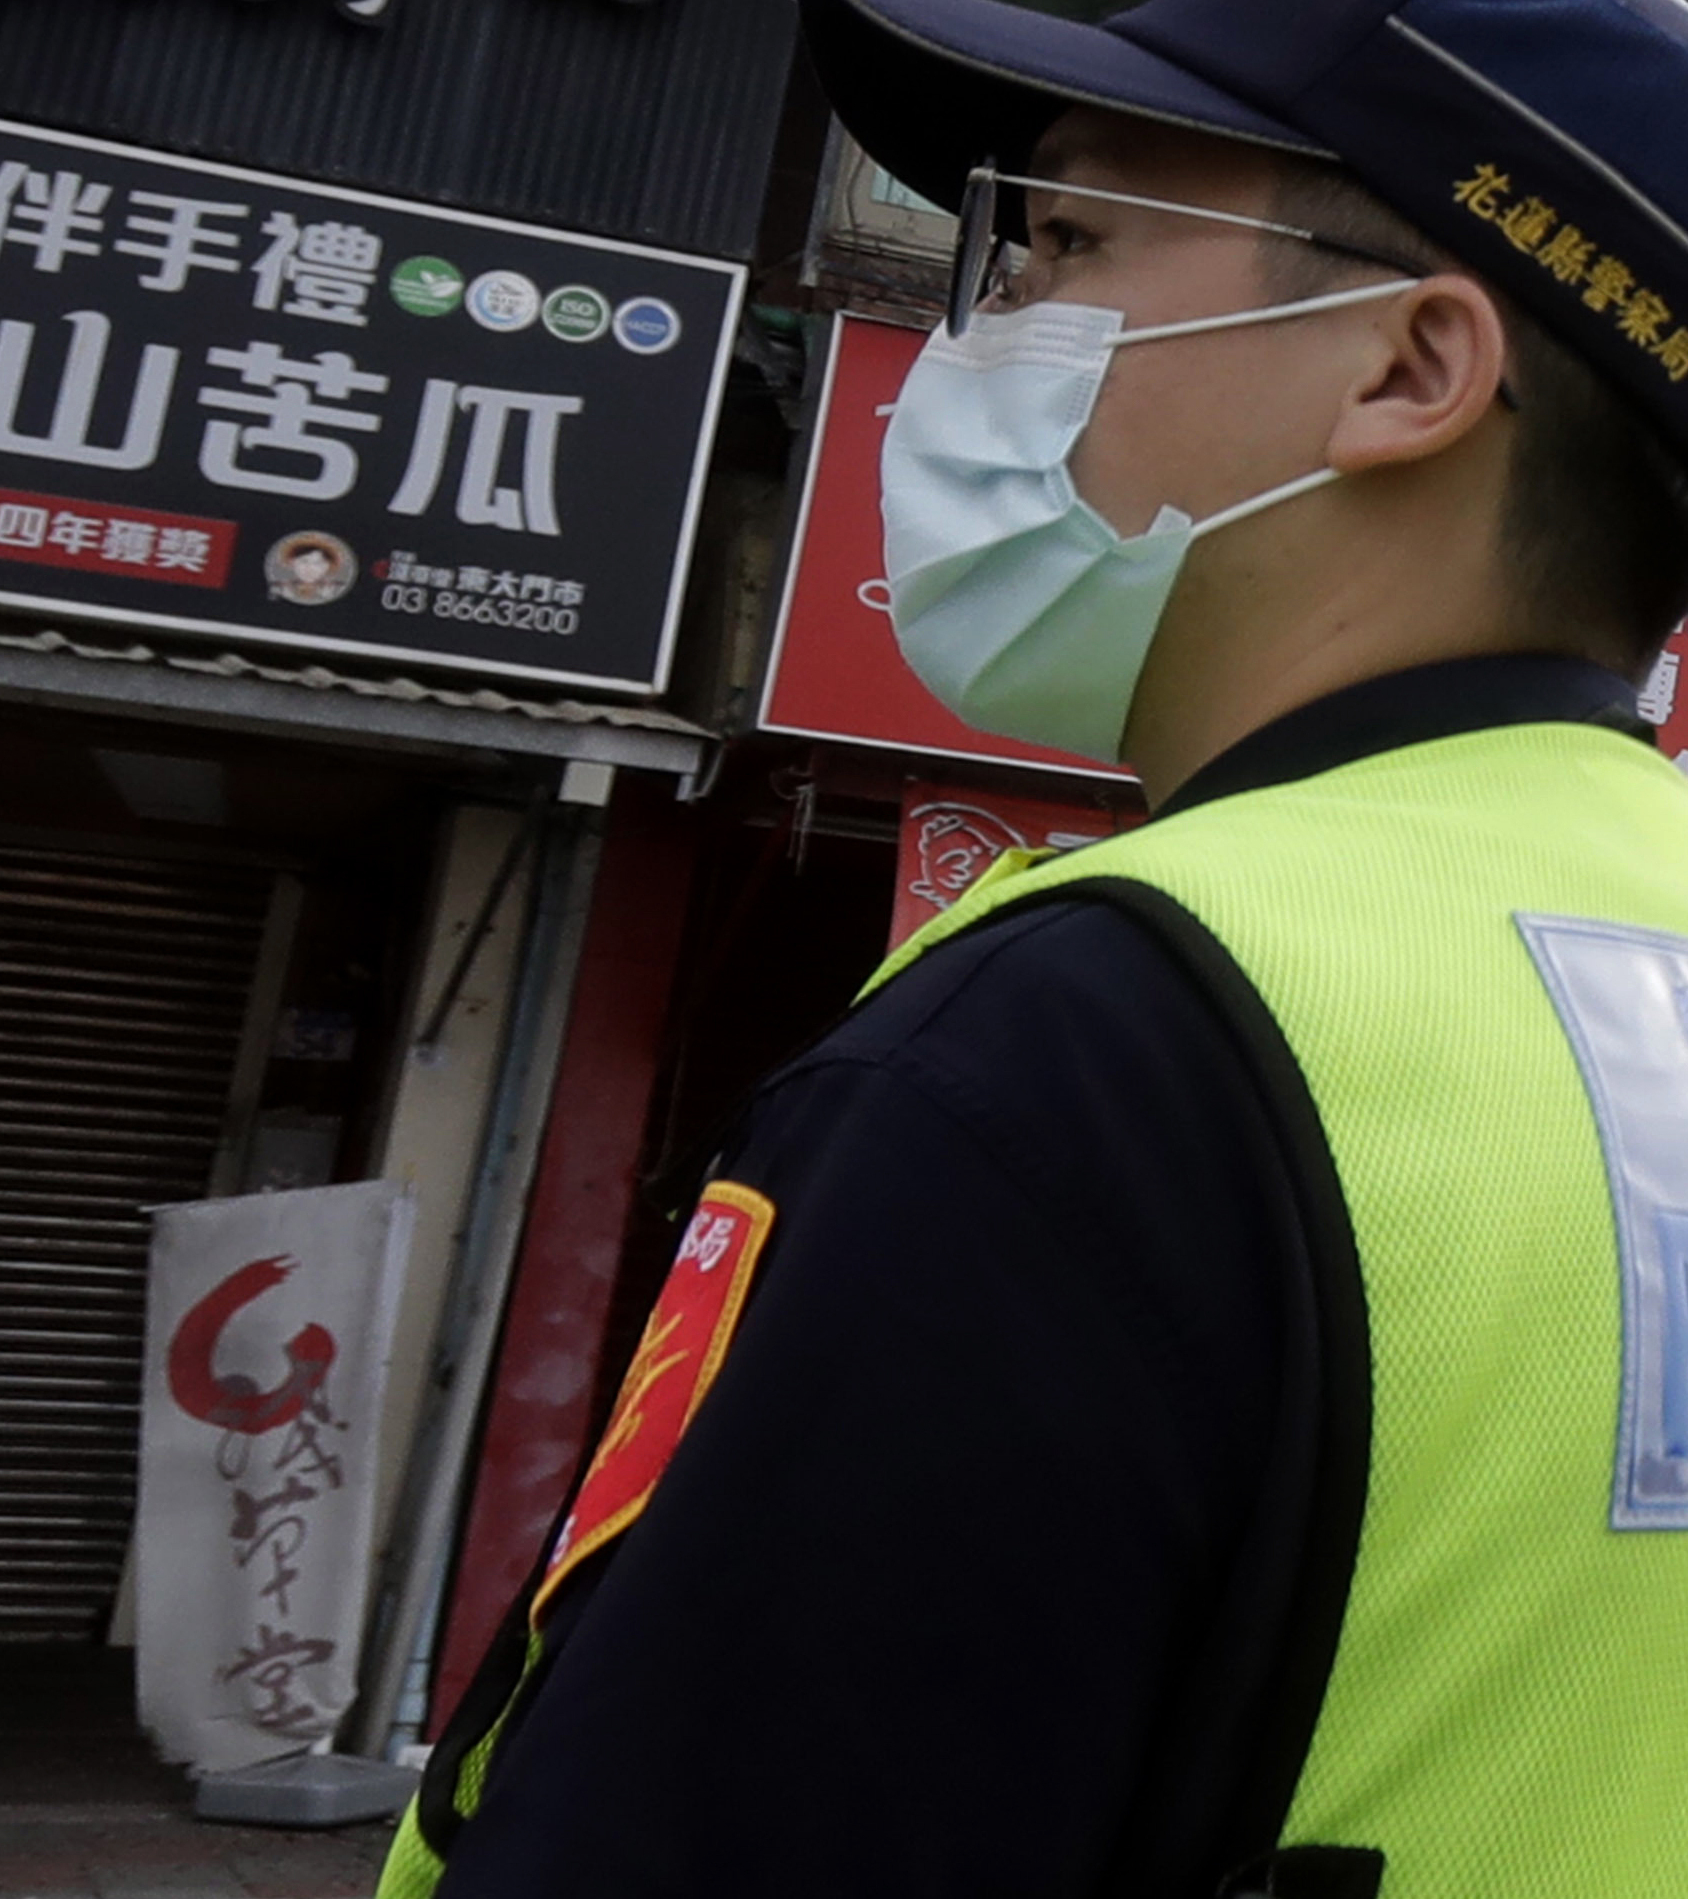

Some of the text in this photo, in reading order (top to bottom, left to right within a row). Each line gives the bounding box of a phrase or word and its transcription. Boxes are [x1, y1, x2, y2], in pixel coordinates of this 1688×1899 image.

[0, 160, 383, 327] 伴手禮
[0, 310, 584, 537] 山苦瓜
[380, 583, 429, 614] 03
[432, 591, 580, 636] 8663200
